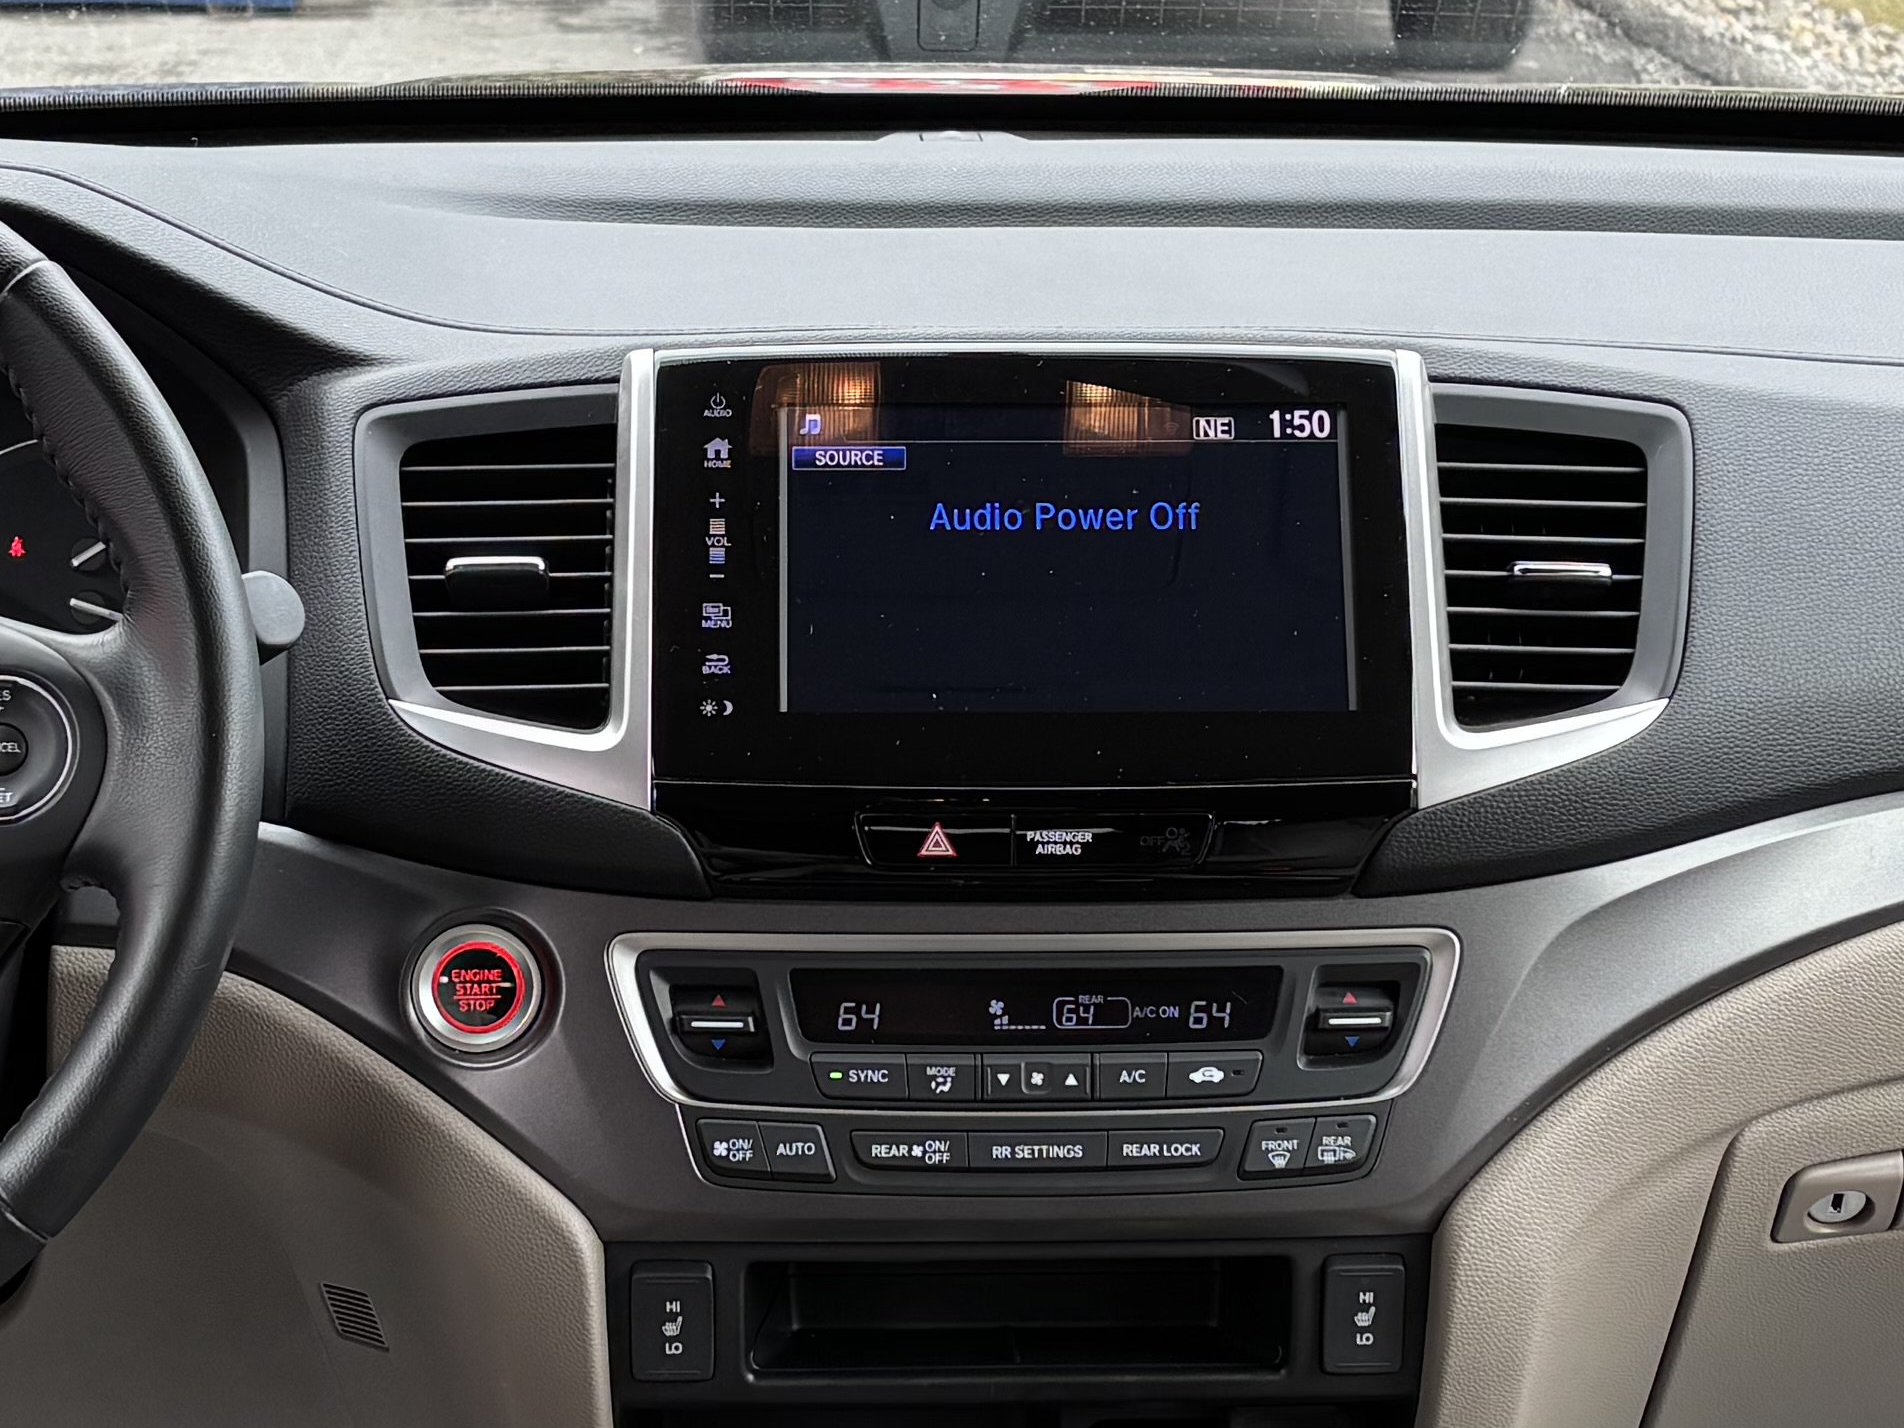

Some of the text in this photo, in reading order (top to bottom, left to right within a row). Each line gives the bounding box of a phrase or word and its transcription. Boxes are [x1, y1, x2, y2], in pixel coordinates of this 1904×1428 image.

[703, 409, 732, 418] AUDIO
[1199, 409, 1333, 440] NE 1:50
[704, 458, 732, 468] HOME
[814, 450, 884, 467] SOURCE
[929, 501, 1202, 532] Audio Power Off
[705, 535, 732, 547] VOL
[701, 617, 733, 628] MENU
[701, 664, 732, 675] BACK
[1026, 831, 1094, 843] PASSENGER
[1035, 843, 1083, 856] AIRBAG
[450, 968, 503, 983] ENGINE
[455, 982, 498, 995] START
[458, 999, 496, 1012] STOP
[1078, 995, 1104, 1005] REAR
[837, 1002, 881, 1031] 64
[1062, 1004, 1095, 1026] 64
[1132, 1006, 1180, 1019] A/C ON
[1189, 1000, 1231, 1029] 64
[848, 1069, 889, 1084] SYNC
[926, 1066, 957, 1078] MODE
[1119, 1069, 1147, 1084] A/C
[729, 1138, 754, 1151] ON/
[1261, 1139, 1300, 1151] FRONT
[1322, 1136, 1352, 1147] REAR
[776, 1142, 816, 1156] AUTO
[871, 1139, 950, 1158] REAR ON/
[992, 1144, 1084, 1159] RR SETTINGS
[1123, 1143, 1202, 1157] REAR LOCK
[729, 1151, 754, 1162] OFF
[925, 1152, 951, 1164] OFF
[1359, 1291, 1374, 1304] HI
[665, 1300, 681, 1313] HI
[1356, 1332, 1374, 1345] LO
[665, 1342, 683, 1355] LO
